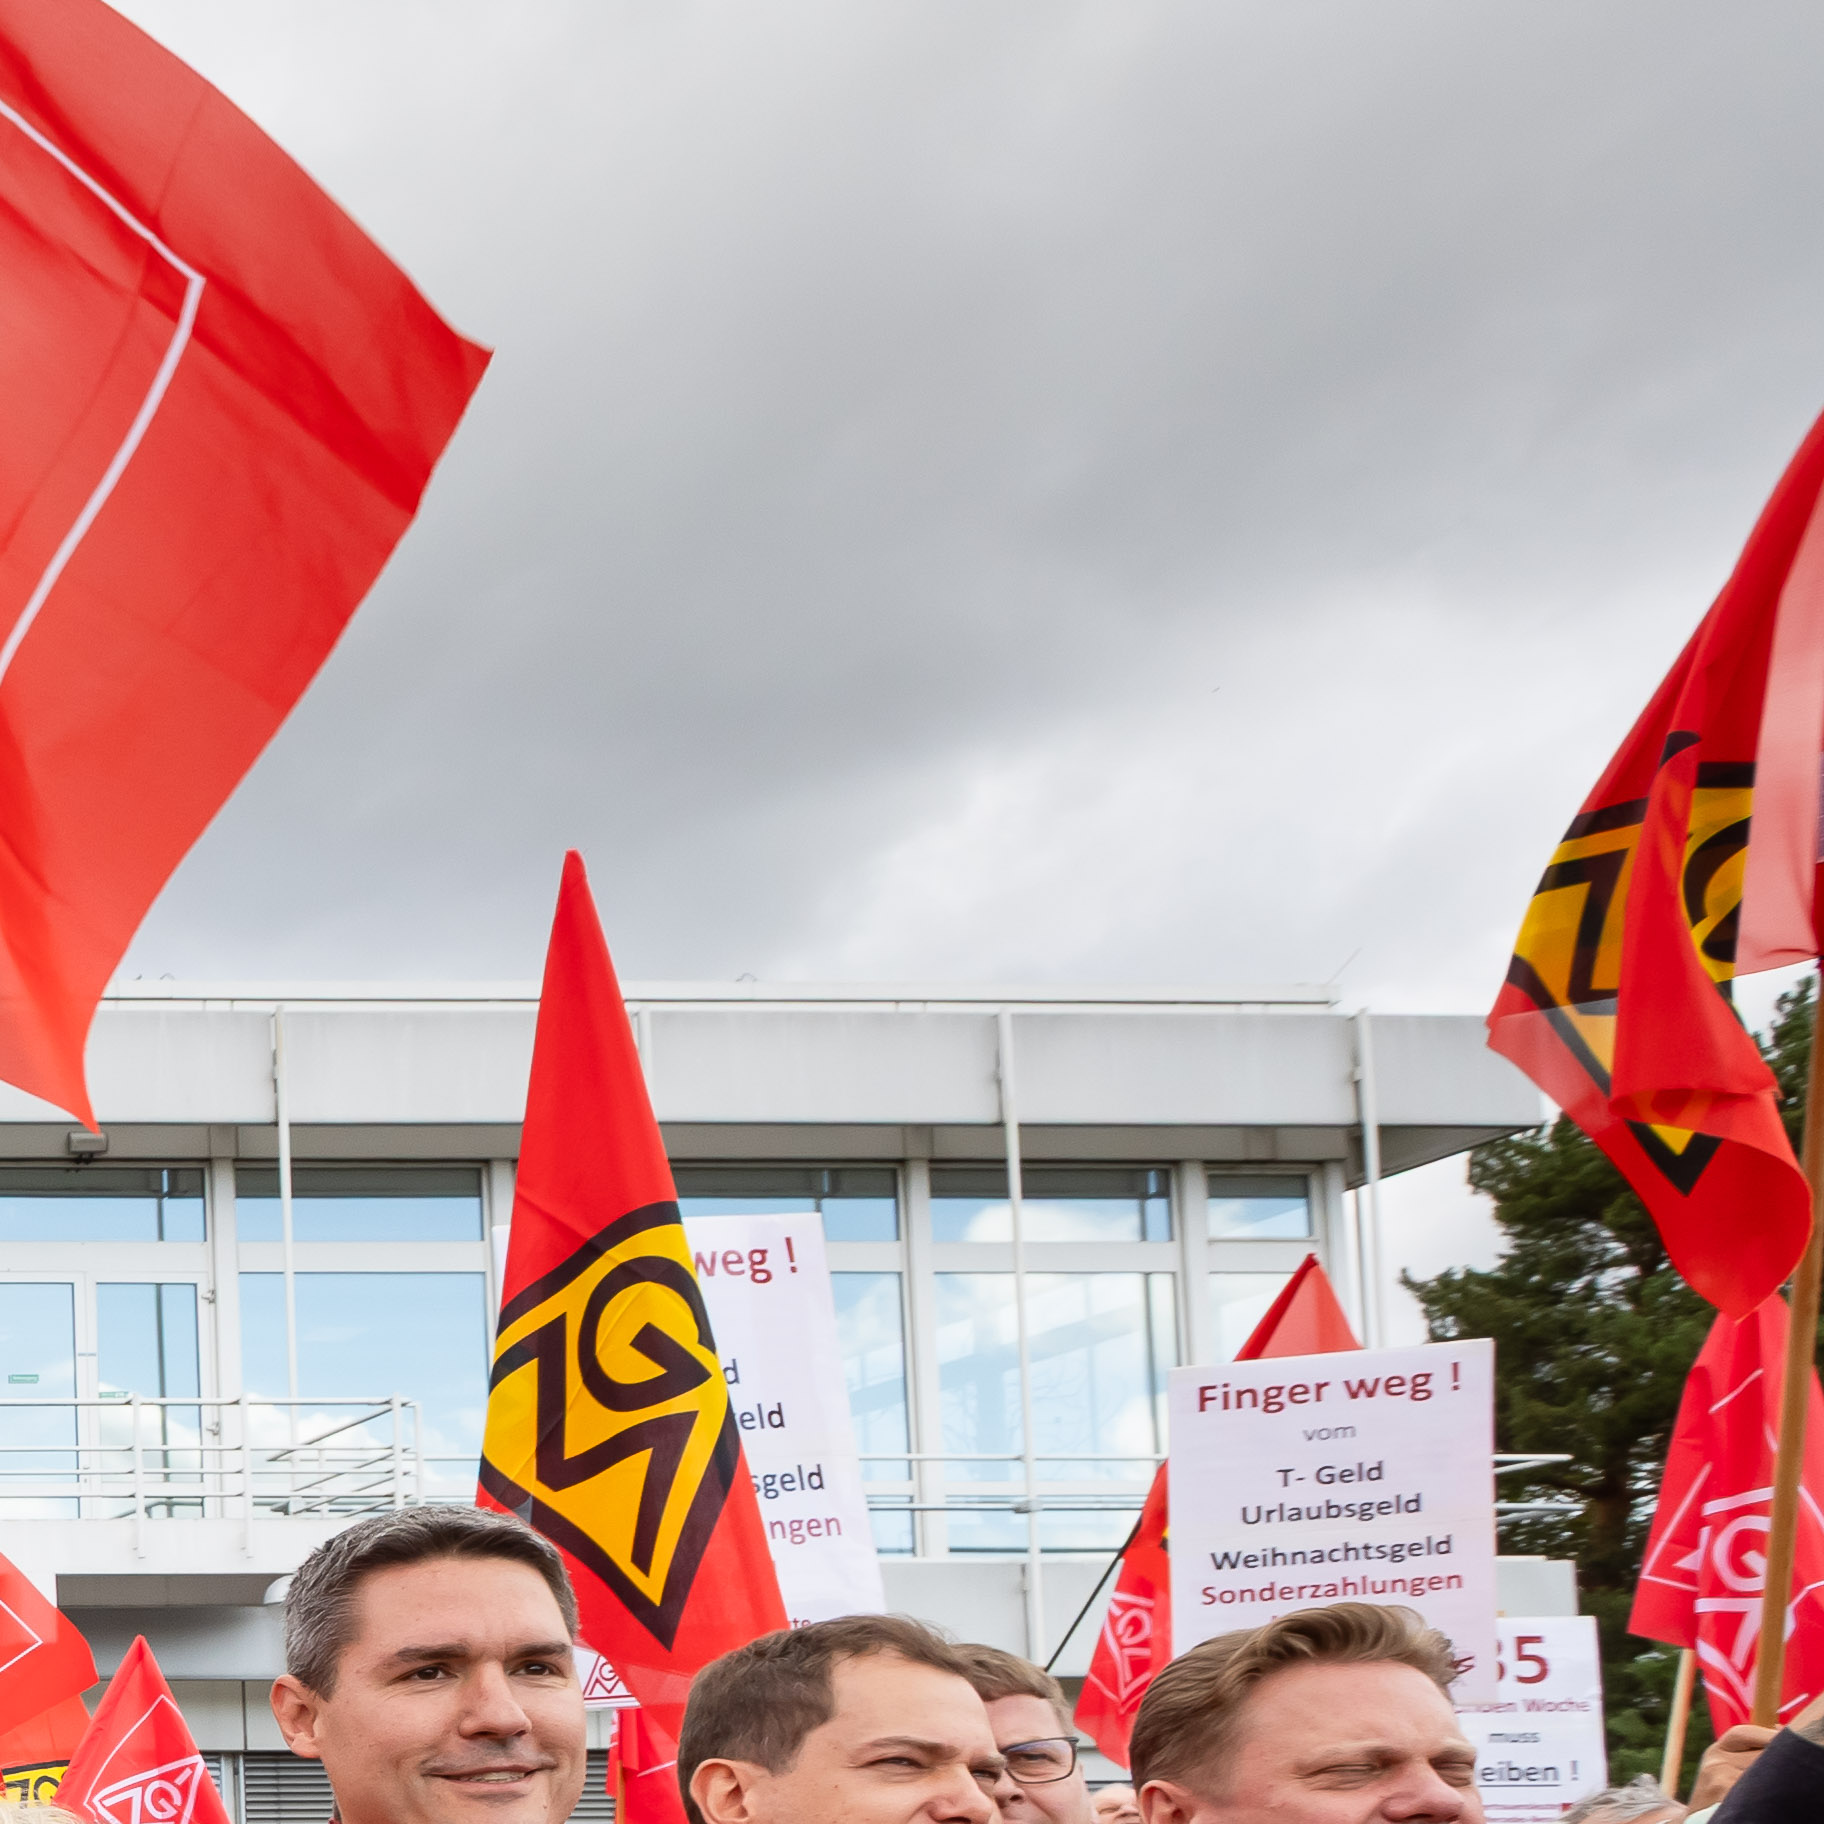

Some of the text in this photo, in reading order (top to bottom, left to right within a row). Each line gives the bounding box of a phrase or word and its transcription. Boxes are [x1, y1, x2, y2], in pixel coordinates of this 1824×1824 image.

[787, 1236, 798, 1274] !
[1197, 1361, 1462, 1415] Finger weg !
[1302, 1424, 1357, 1442] vom
[1277, 1461, 1385, 1488] T- Geld
[1241, 1492, 1423, 1526] Urlaubsgeld
[1210, 1534, 1453, 1572] Weihnachtsgeld
[1201, 1572, 1464, 1606] Sonderzahlungen
[1496, 1635, 1549, 1684] 5
[1569, 1760, 1579, 1781] !
